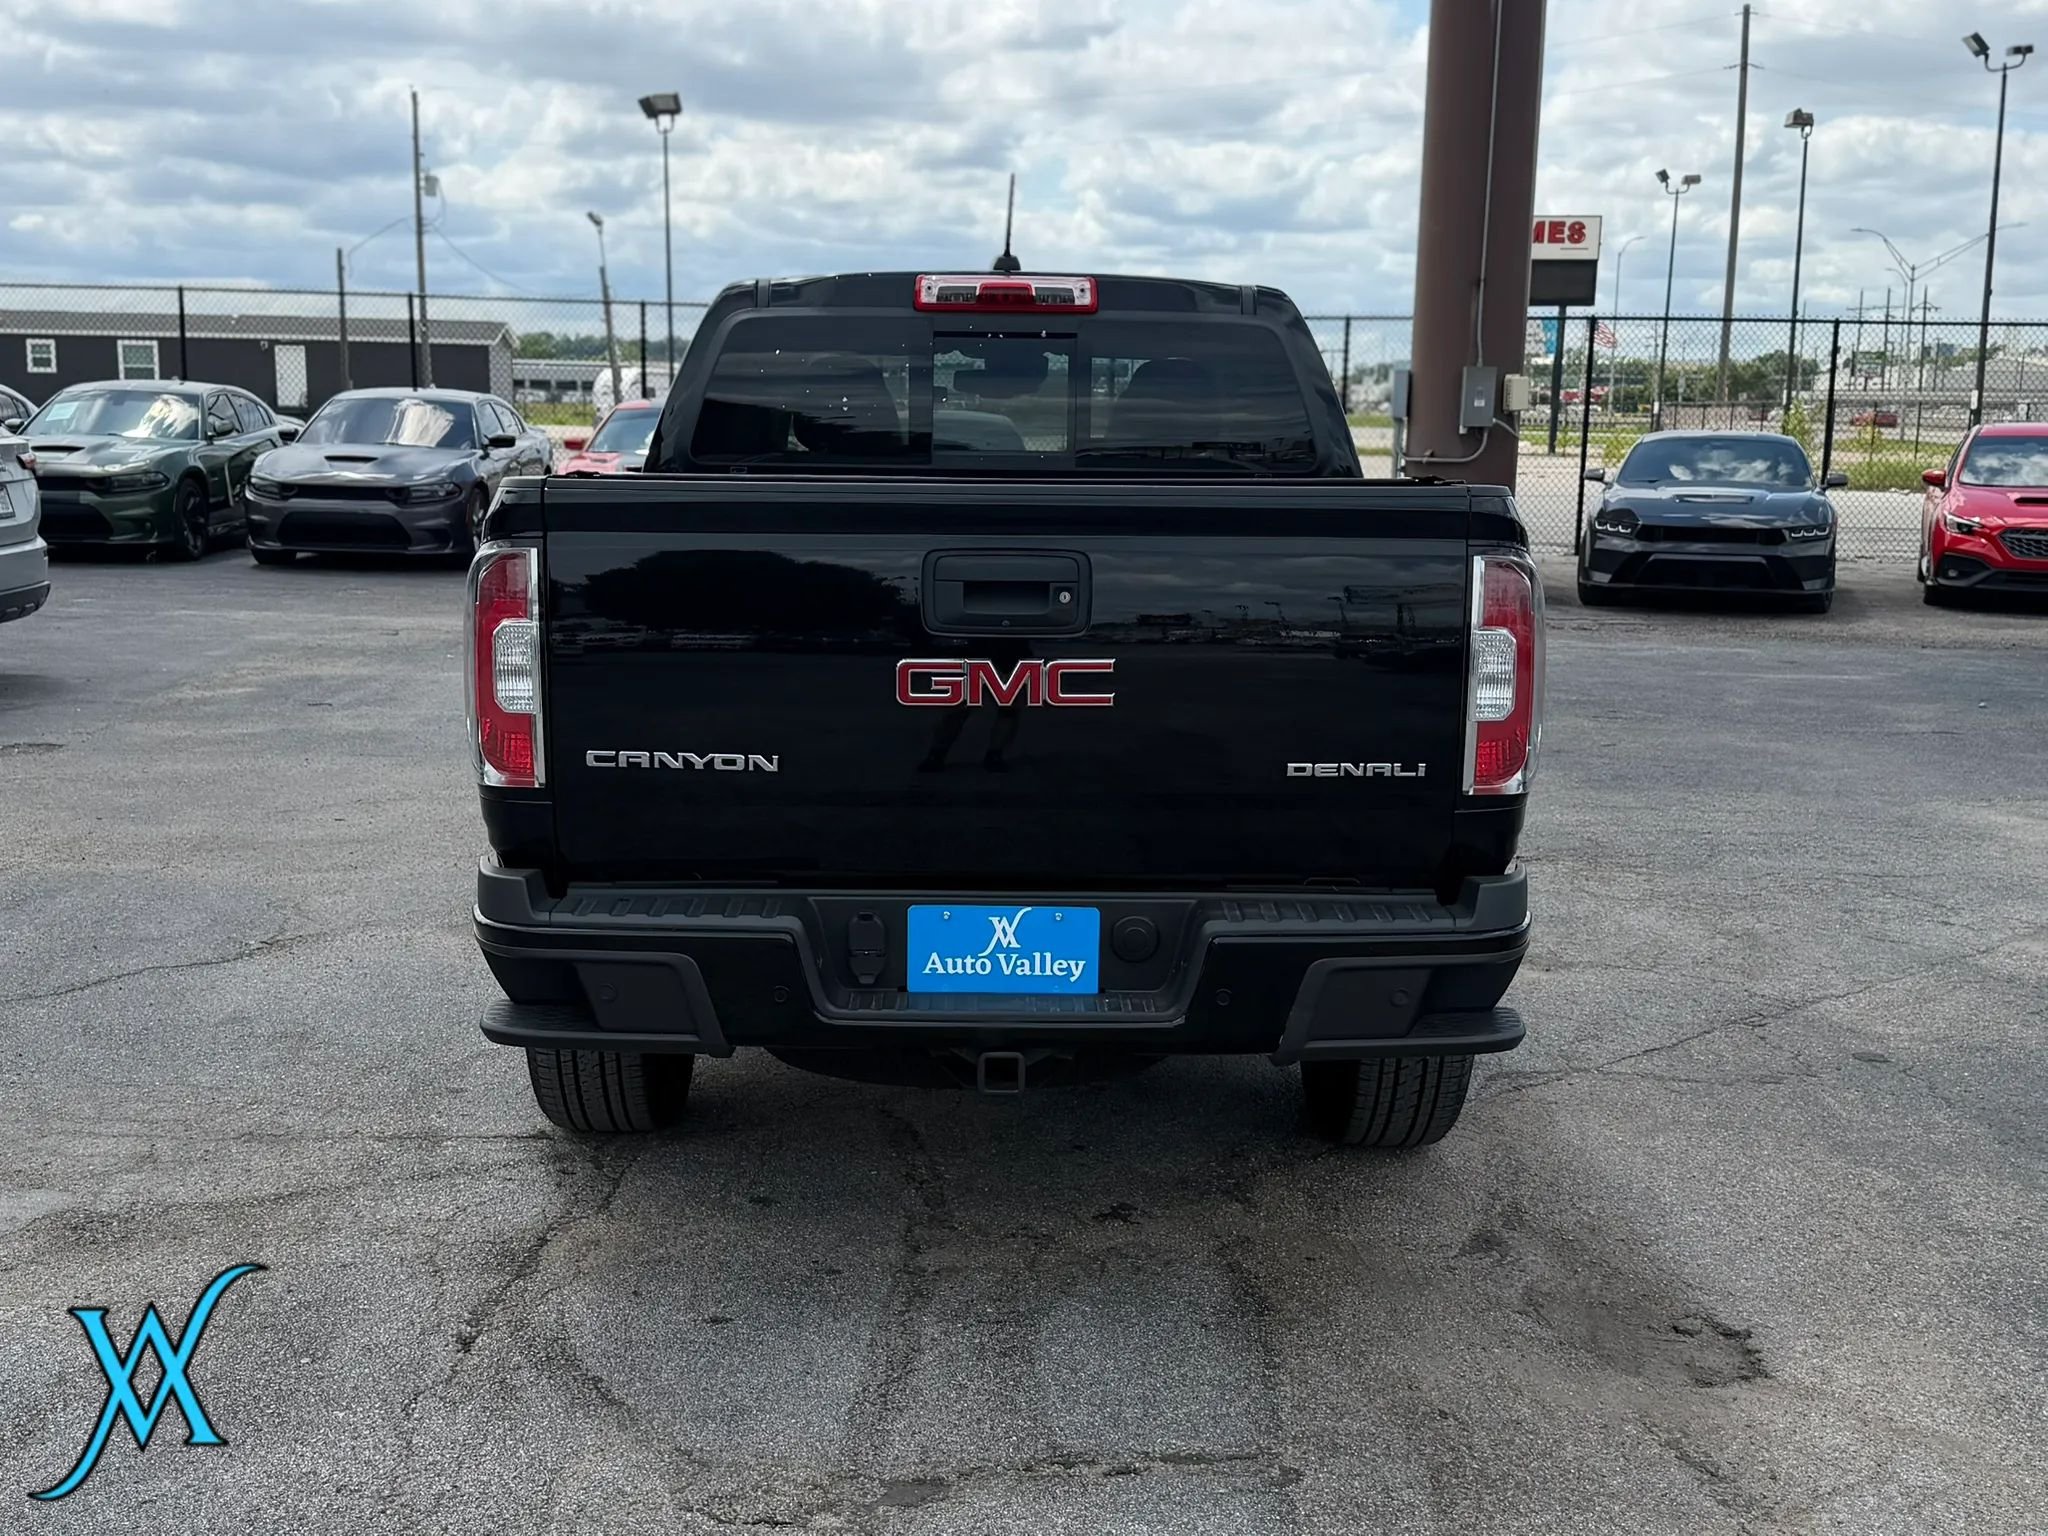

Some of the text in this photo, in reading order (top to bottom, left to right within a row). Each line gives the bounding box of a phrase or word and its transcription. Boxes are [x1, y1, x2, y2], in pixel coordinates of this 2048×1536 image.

[895, 658, 1116, 707] GMC
[585, 749, 780, 773] CANYON
[922, 951, 1087, 983] Auto Valley
